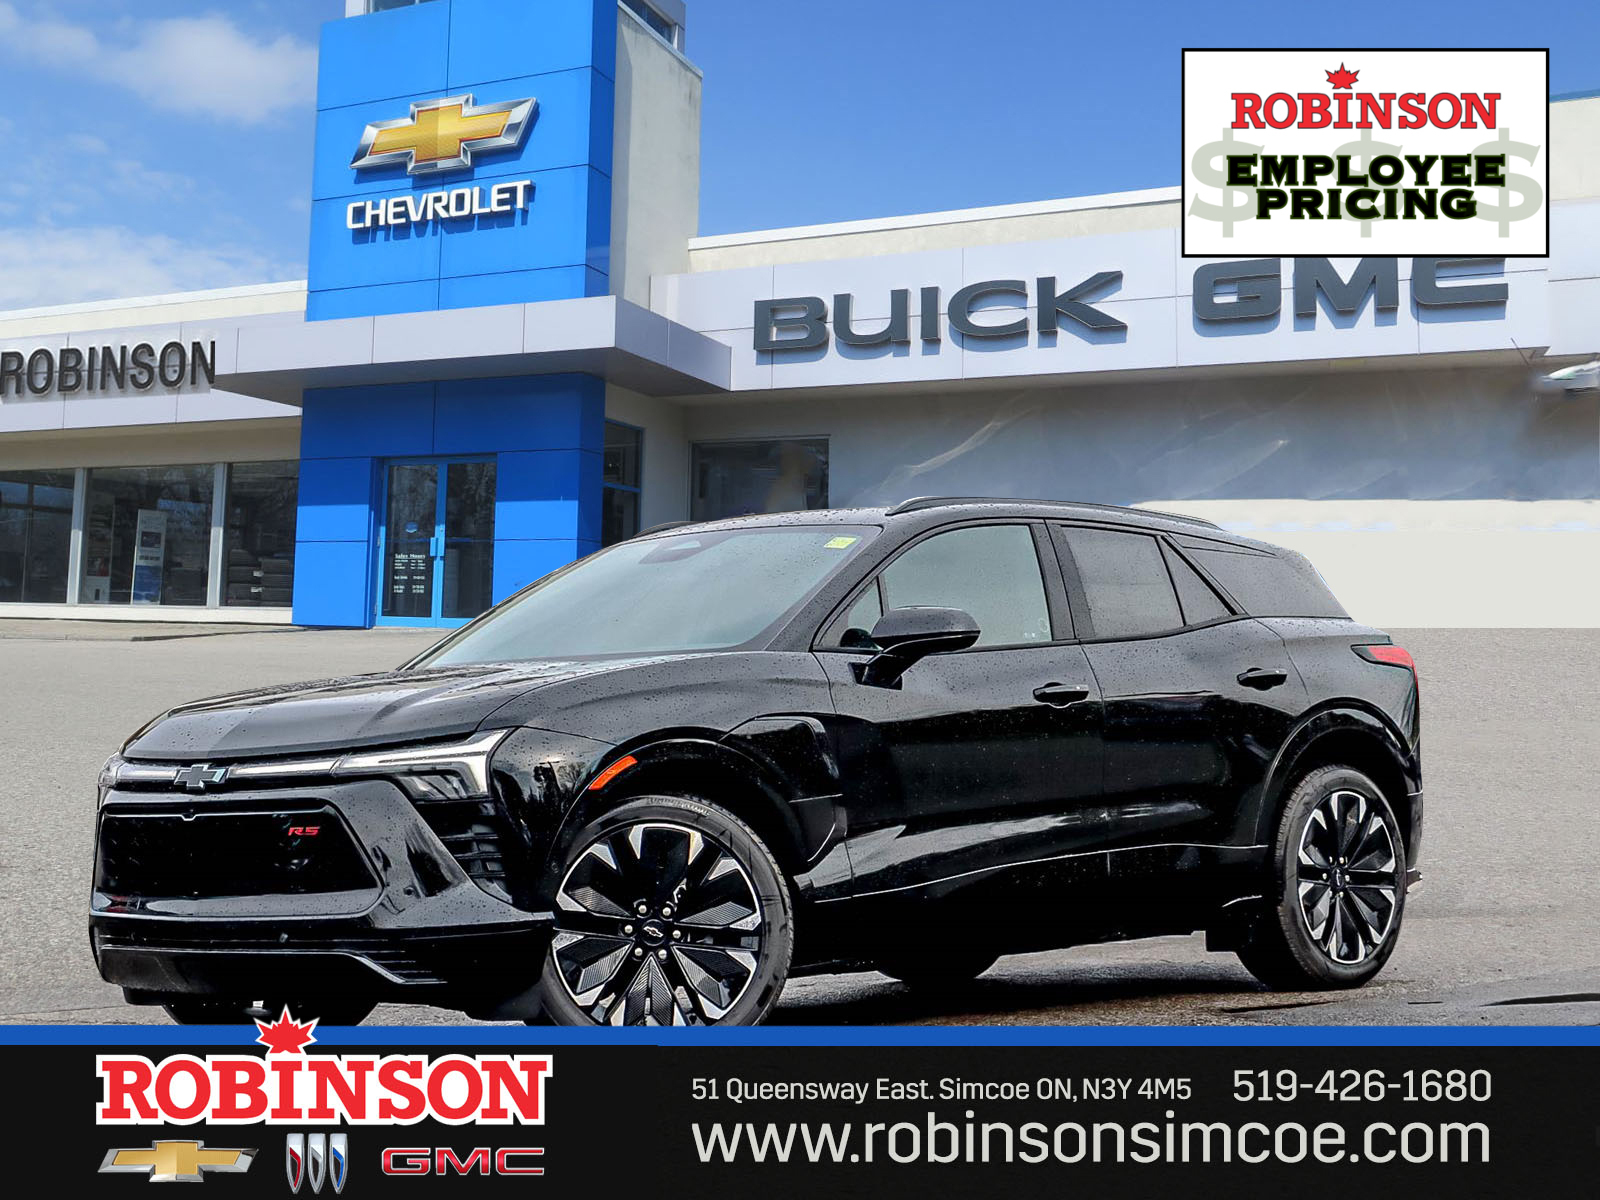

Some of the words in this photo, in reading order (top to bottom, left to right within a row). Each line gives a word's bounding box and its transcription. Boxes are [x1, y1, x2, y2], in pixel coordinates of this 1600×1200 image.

[346, 180, 536, 229] CHEVROLET
[753, 270, 1129, 351] BUICK
[1193, 257, 1509, 321] GMC
[0, 340, 216, 396] ROBINSON
[288, 826, 321, 836] RS
